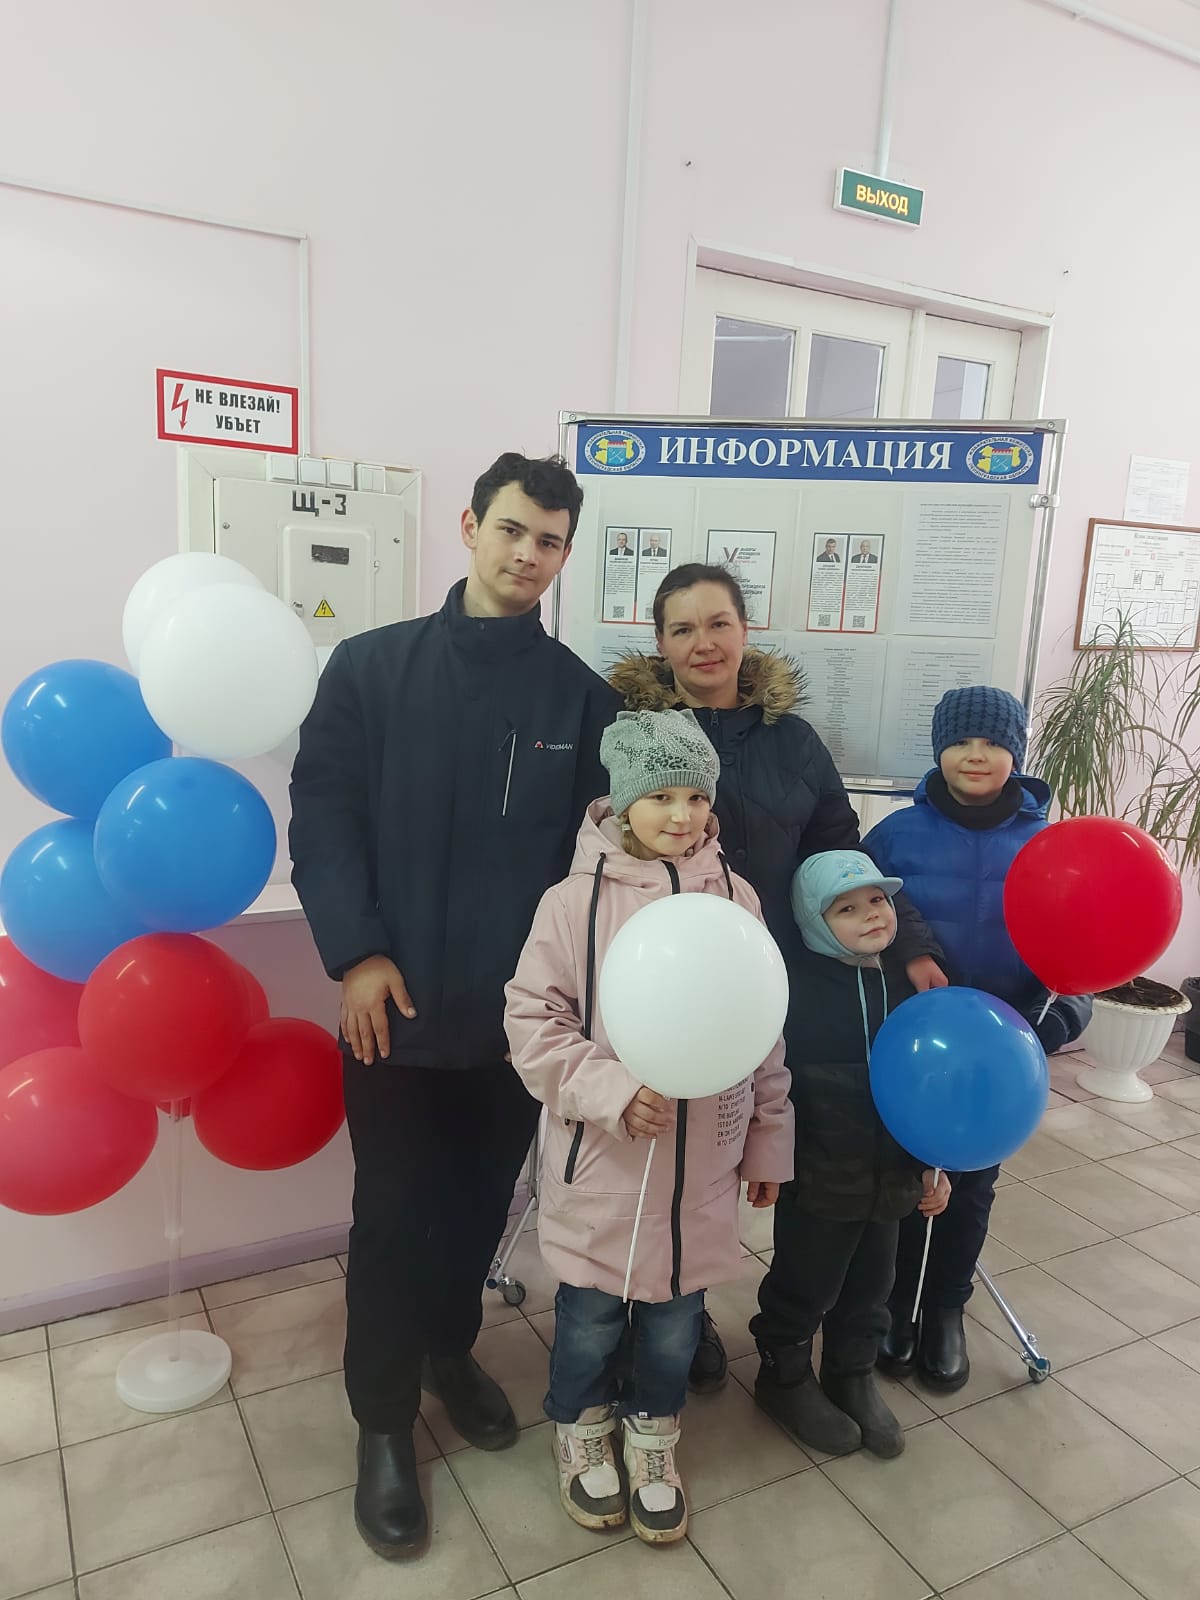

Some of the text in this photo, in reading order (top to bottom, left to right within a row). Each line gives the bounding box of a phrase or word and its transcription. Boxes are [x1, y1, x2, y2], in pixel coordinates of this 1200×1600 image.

[856, 184, 909, 216] ВЫХОД
[195, 388, 280, 413] НЕ ВЛЕЗАЙ!
[216, 414, 261, 433] УБЪЕТ
[656, 436, 955, 476] ИНФОРМАЦИЯ
[292, 490, 347, 517] Щ-3
